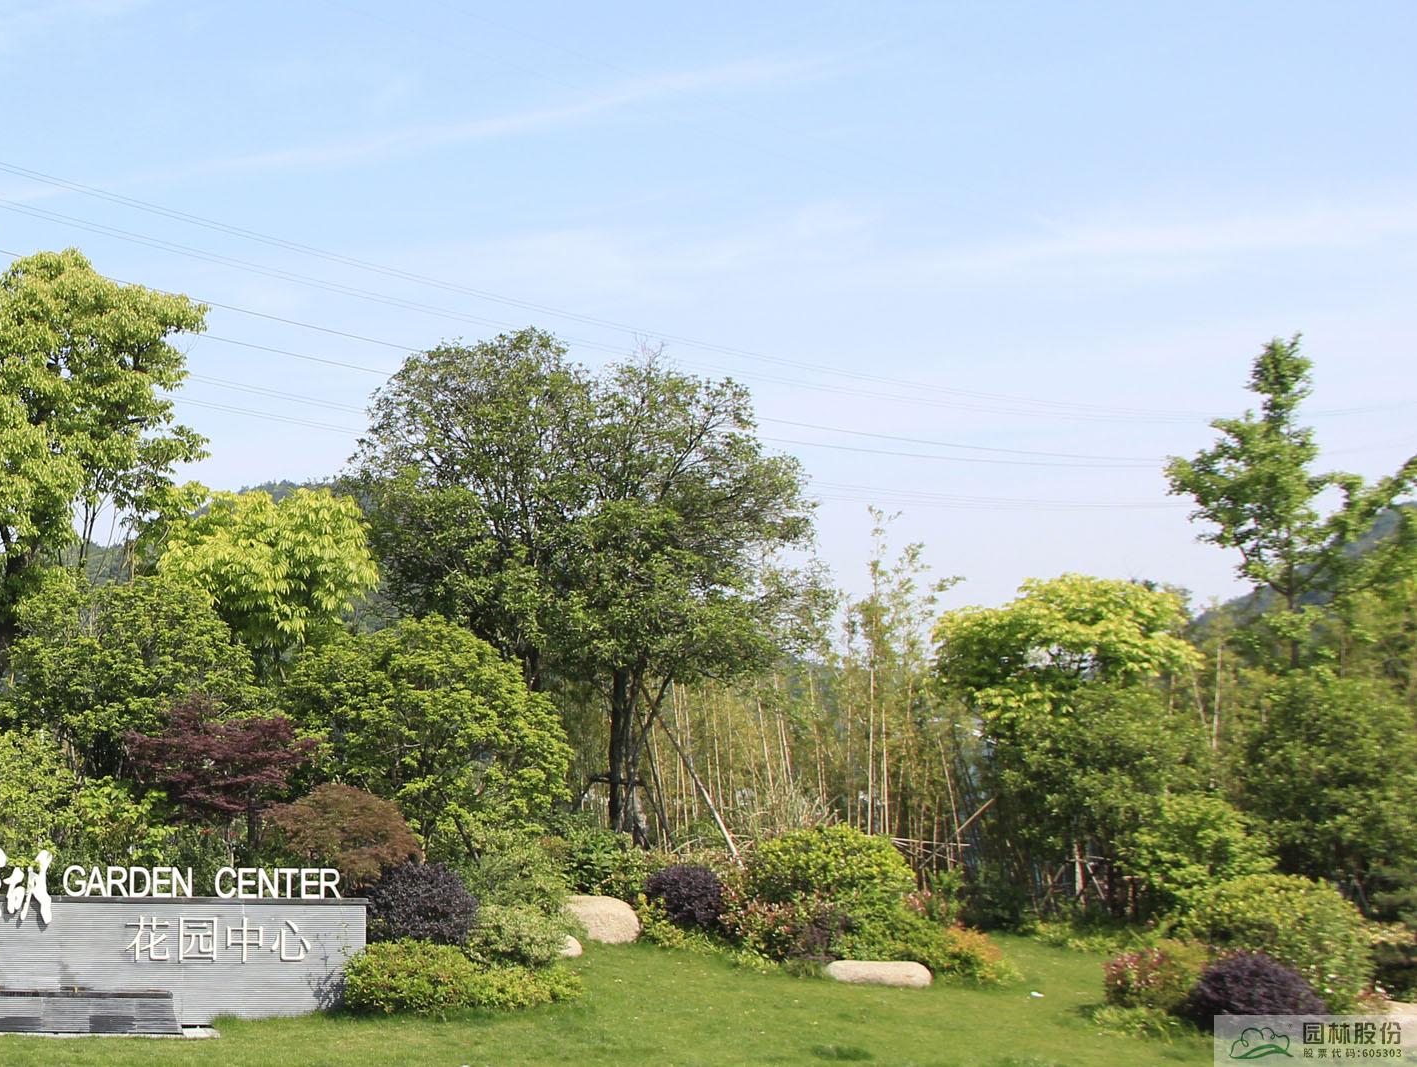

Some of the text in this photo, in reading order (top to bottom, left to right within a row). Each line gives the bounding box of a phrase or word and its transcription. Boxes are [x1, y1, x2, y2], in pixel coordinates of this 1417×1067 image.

[63, 865, 340, 899] GARDEN CENTER
[125, 915, 312, 963] 花园中心
